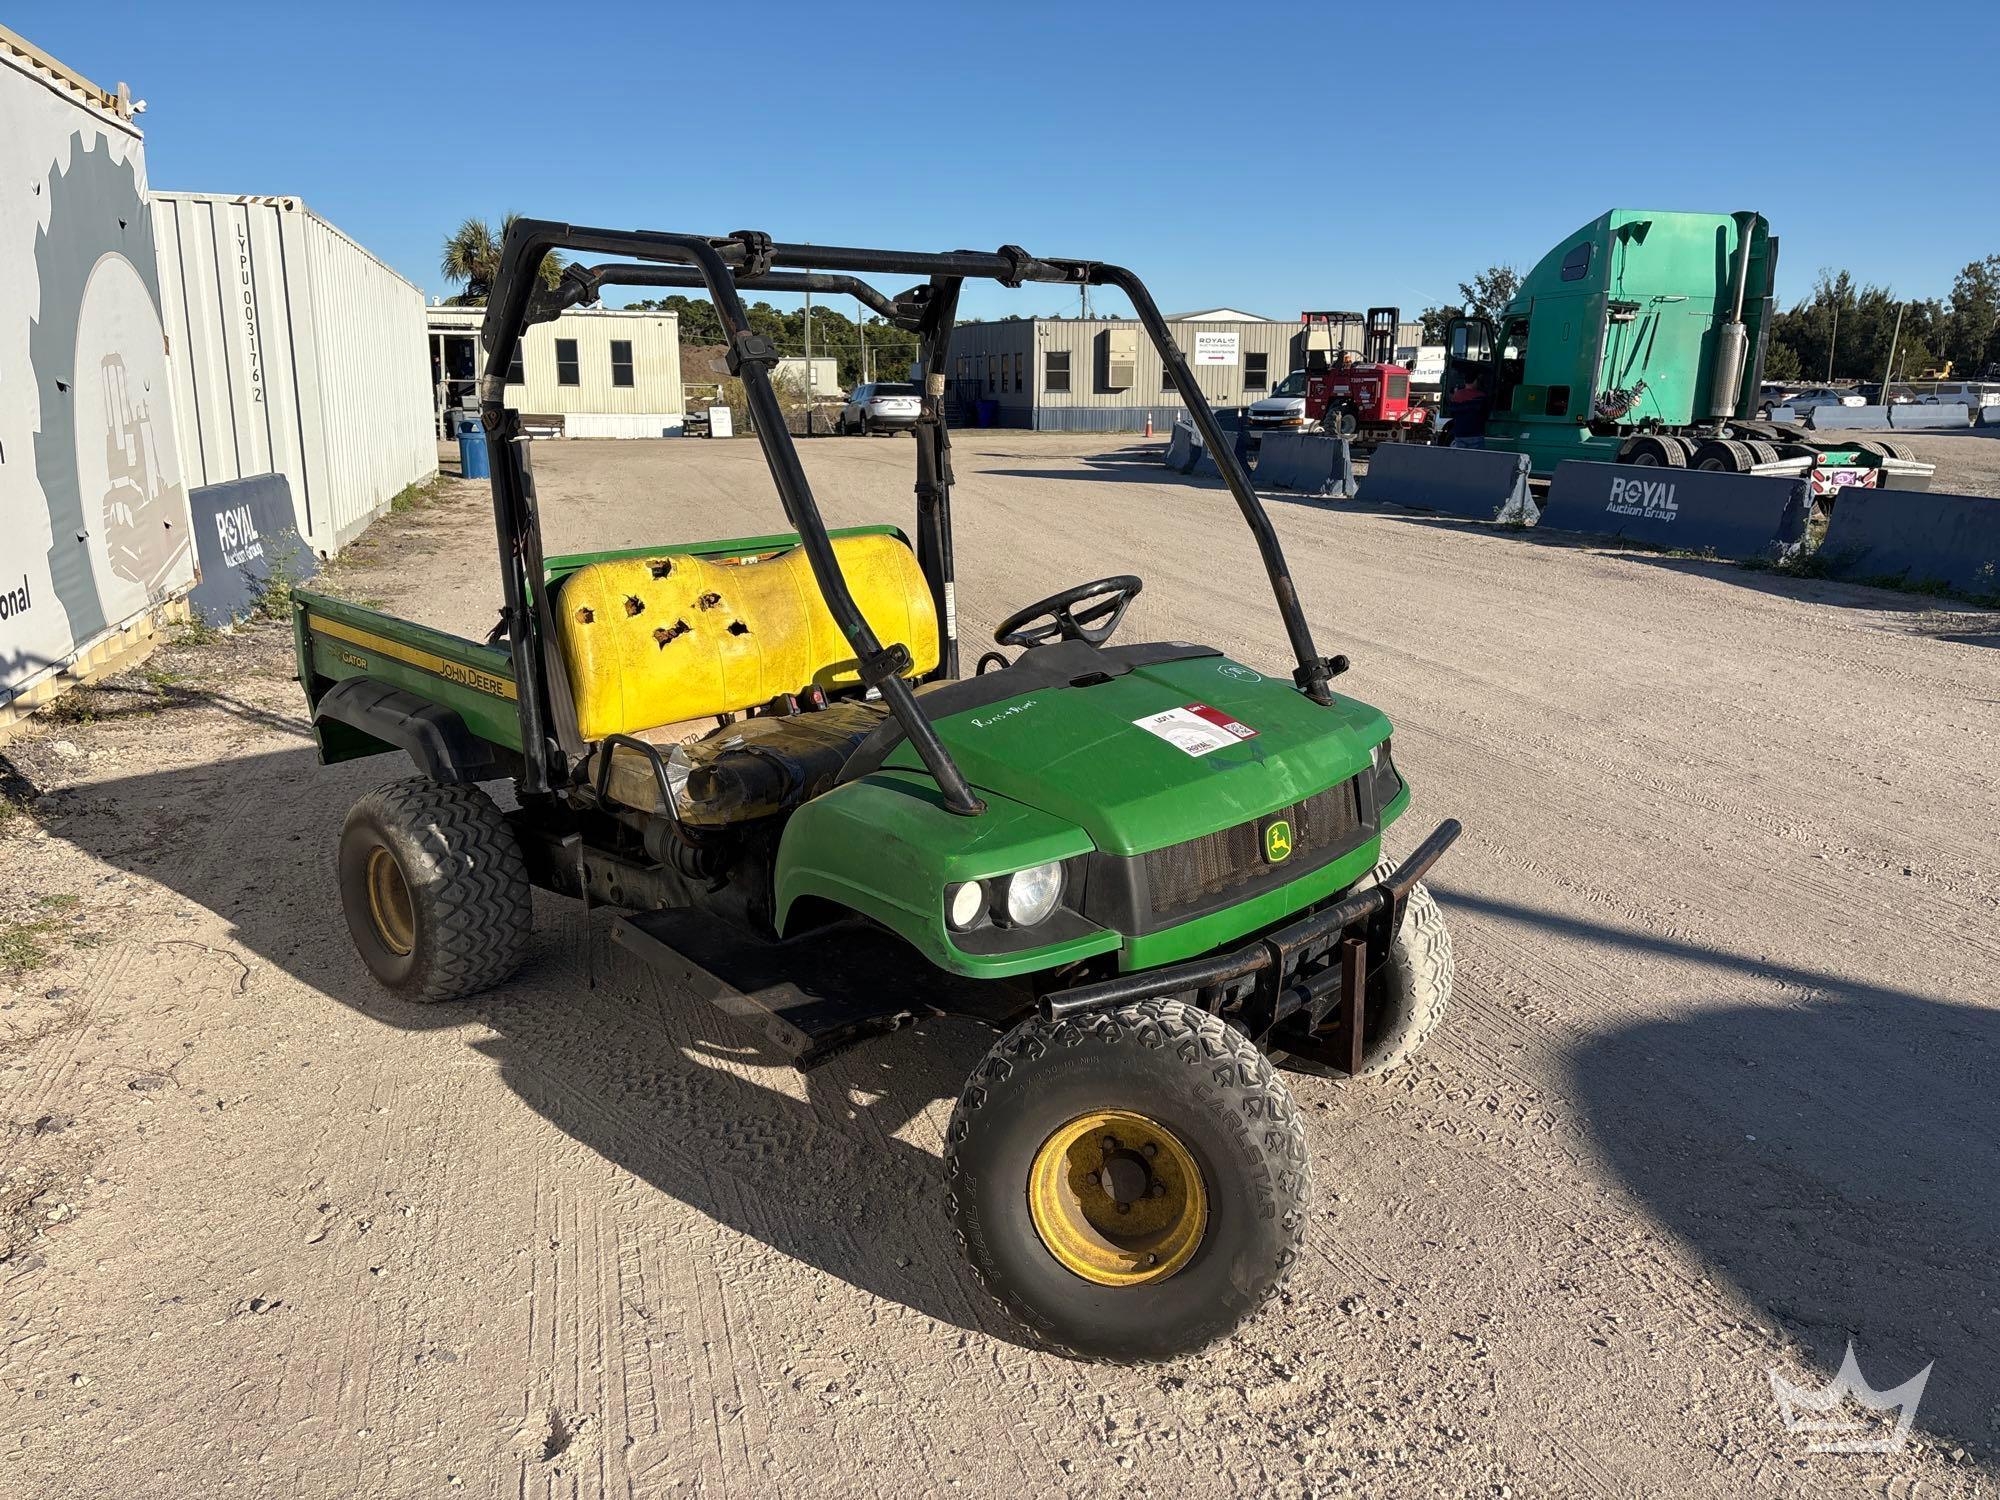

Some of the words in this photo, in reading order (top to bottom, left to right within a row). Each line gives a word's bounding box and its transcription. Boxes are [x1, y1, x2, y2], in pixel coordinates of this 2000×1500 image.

[237, 223, 249, 285] LYPU
[244, 291, 259, 382] 003176
[1609, 477, 1679, 511] ROYAL
[1605, 501, 1643, 516] Auction
[1644, 506, 1677, 522] Group
[215, 504, 259, 551] ROYAL
[245, 542, 264, 560] Group
[342, 651, 367, 669] GATOR
[440, 660, 467, 683] JOHN
[469, 670, 504, 695] DEERE
[1154, 715, 1168, 723] LOT
[1185, 741, 1211, 752] ROYAL
[1192, 1081, 1276, 1220] CARLSTAR
